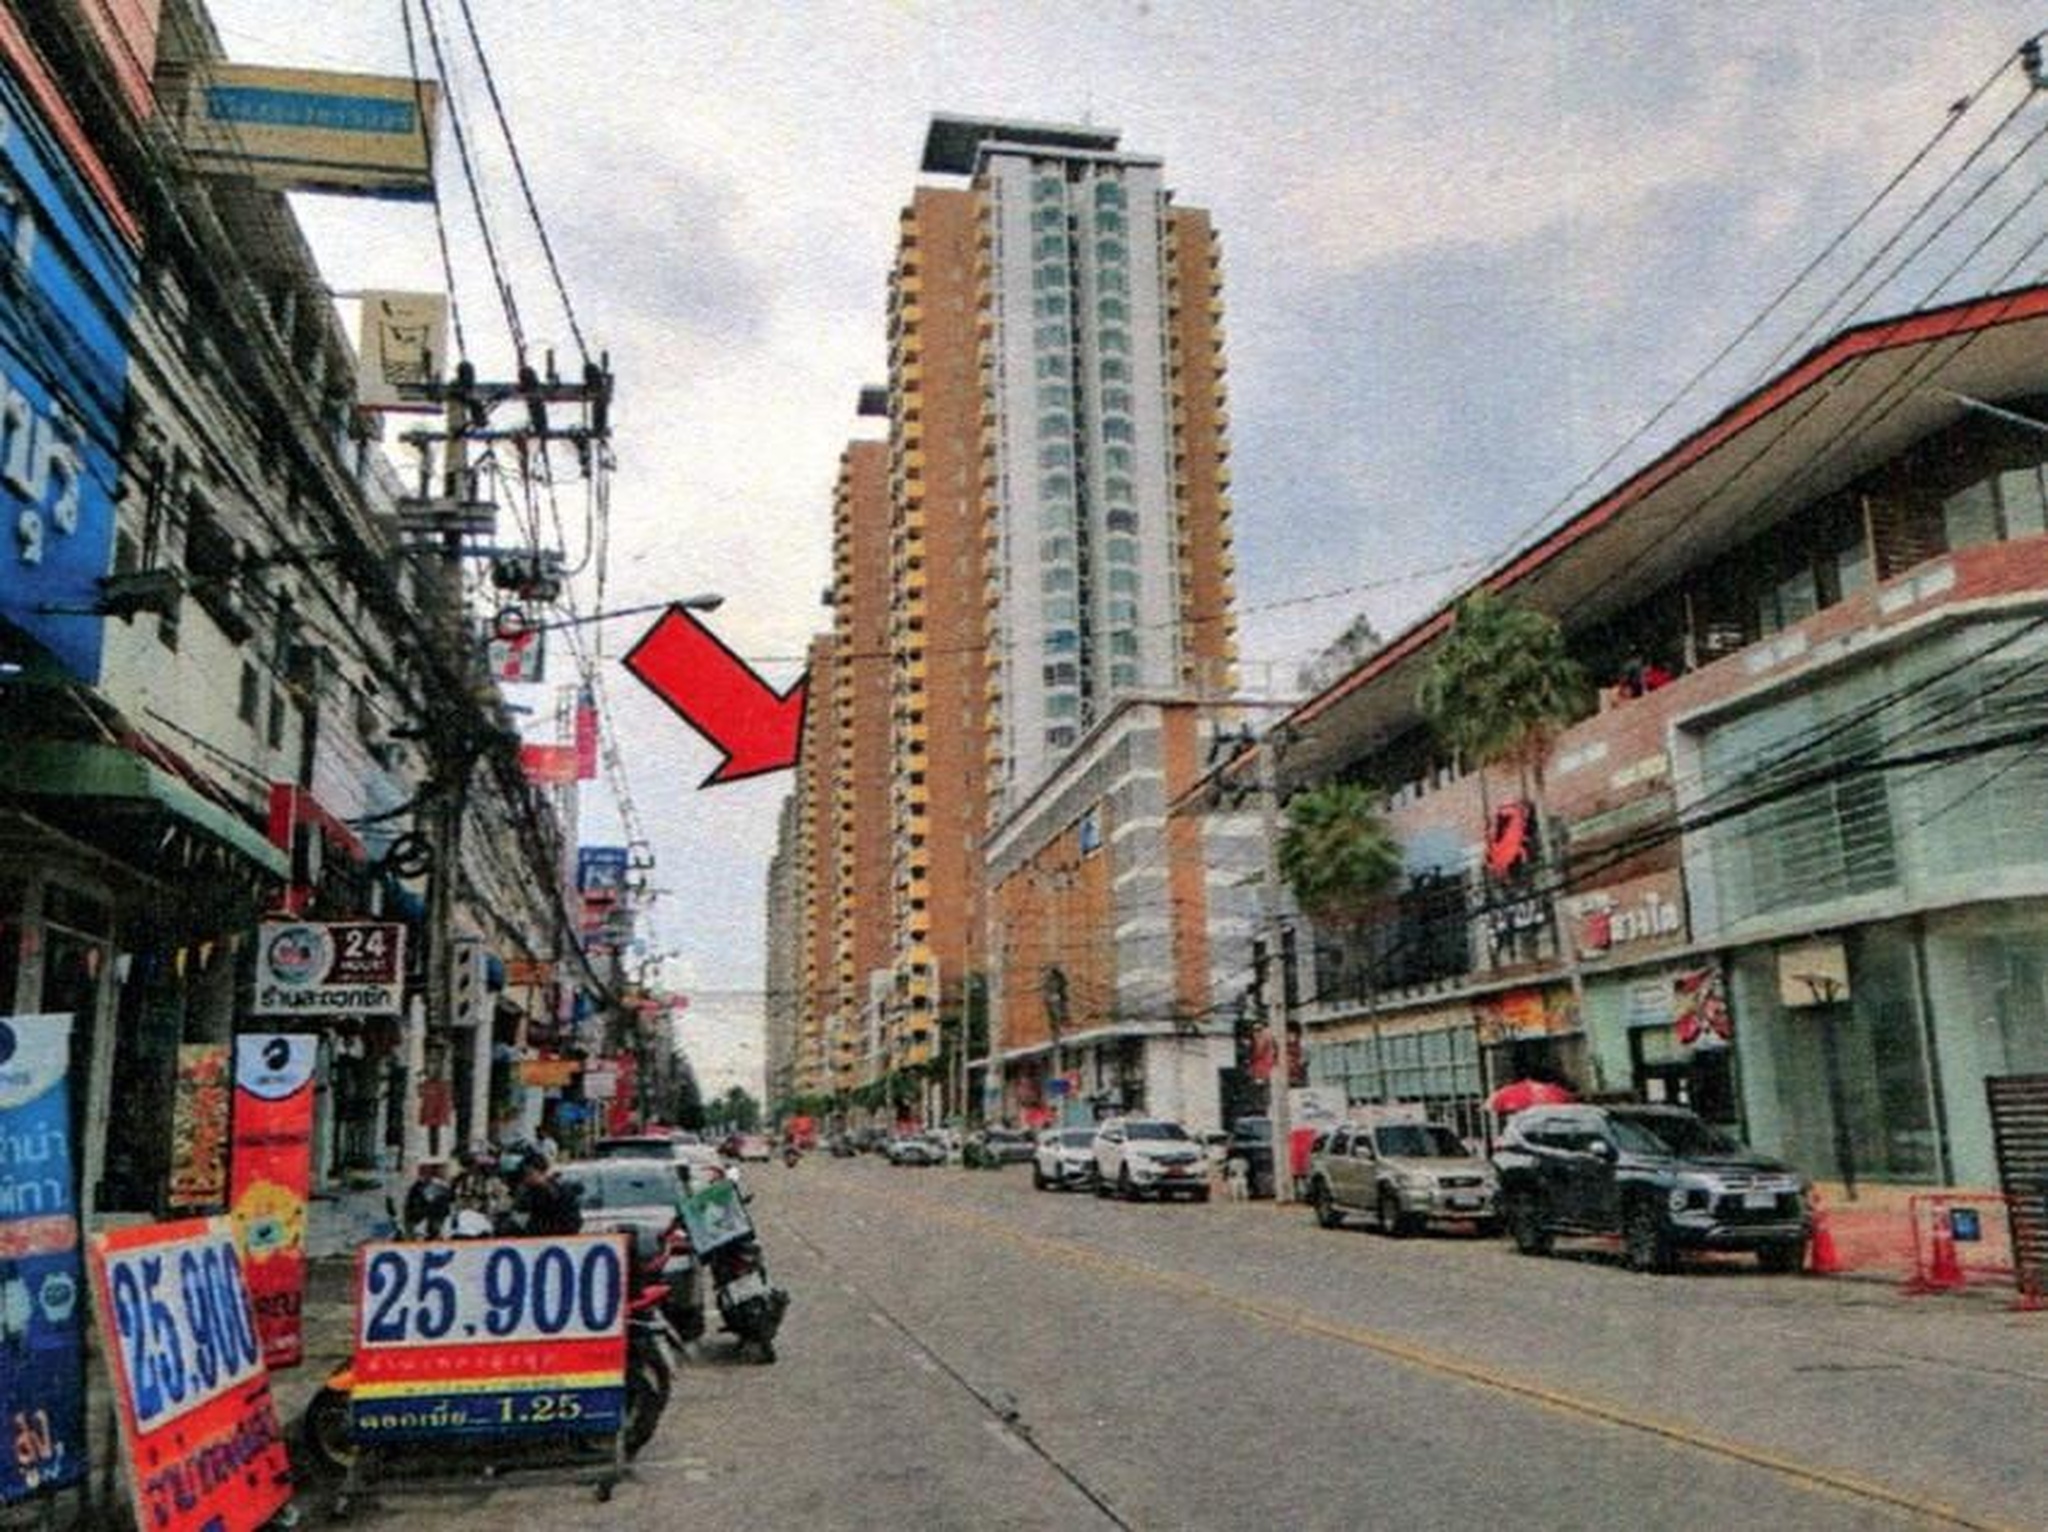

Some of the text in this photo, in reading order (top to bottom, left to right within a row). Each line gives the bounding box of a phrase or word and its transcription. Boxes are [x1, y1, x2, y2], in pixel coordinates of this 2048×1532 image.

[345, 929, 385, 957] 24
[366, 1243, 621, 1342] 25.900
[113, 1242, 257, 1420] 25.900
[498, 1394, 582, 1423] 1.25
